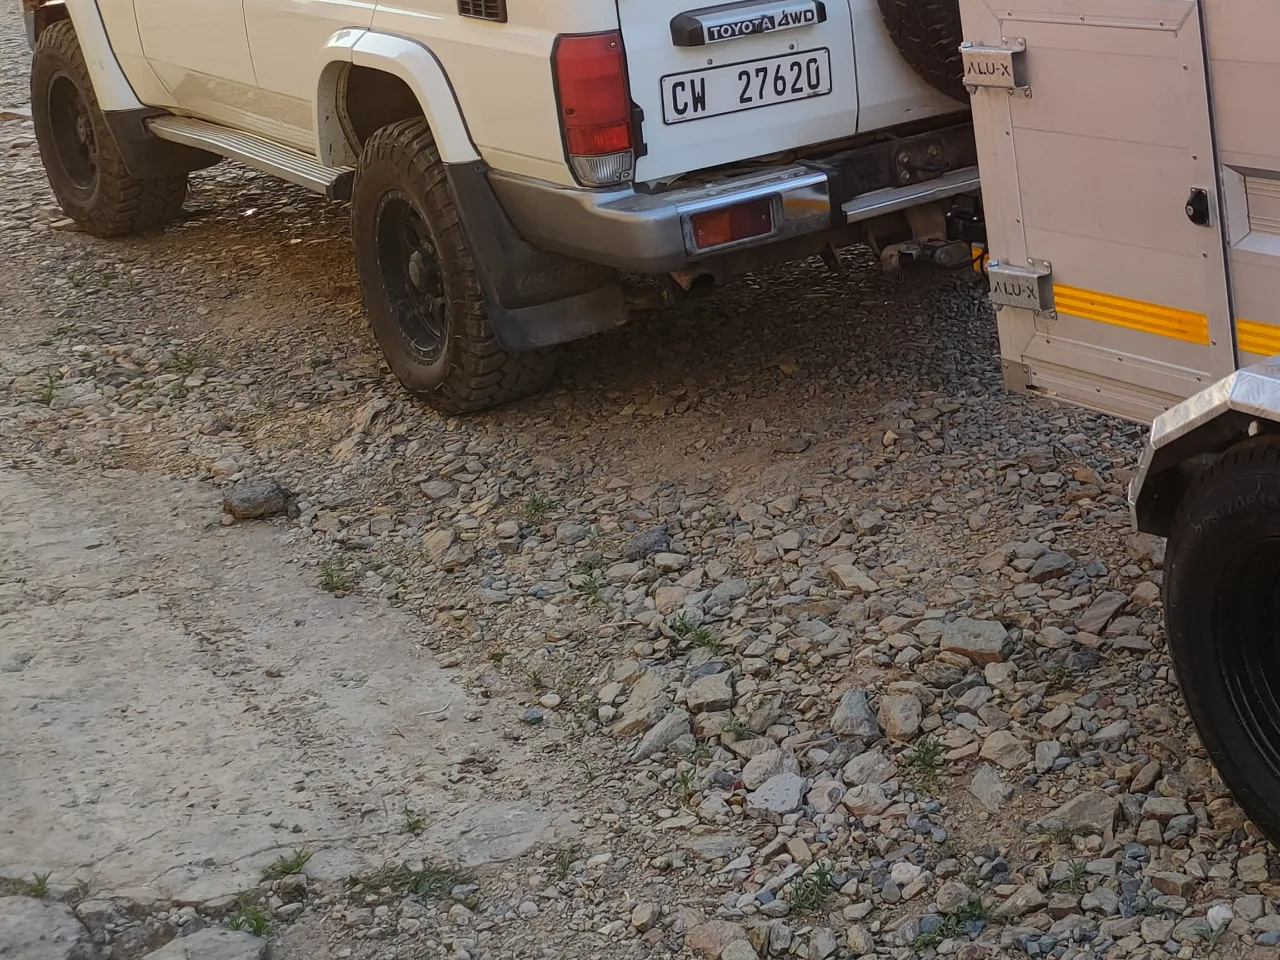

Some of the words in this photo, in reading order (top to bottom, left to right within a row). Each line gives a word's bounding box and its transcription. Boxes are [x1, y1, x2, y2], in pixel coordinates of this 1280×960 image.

[710, 18, 773, 40] TOYOTA
[778, 9, 815, 27] 4WD
[967, 61, 1011, 77] ALU-X
[671, 76, 706, 116] CW
[737, 57, 821, 104] 27620
[994, 281, 1037, 300] ALU-X
